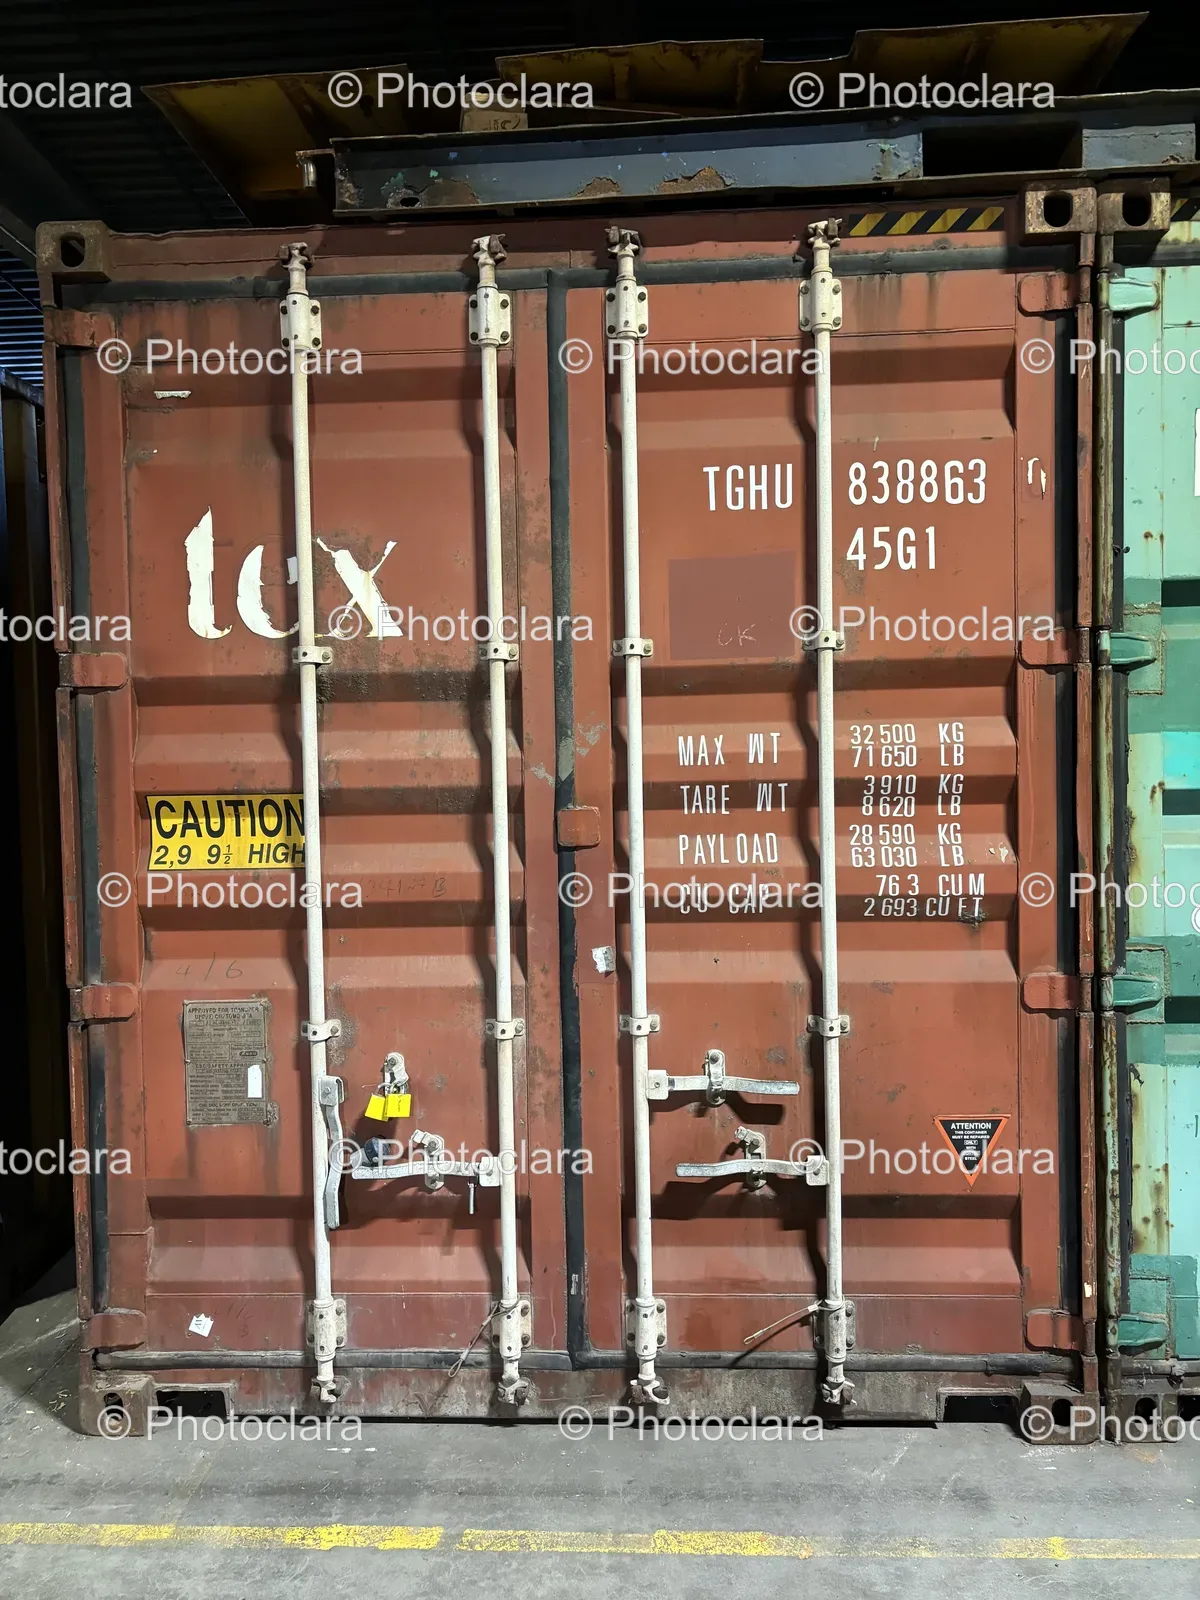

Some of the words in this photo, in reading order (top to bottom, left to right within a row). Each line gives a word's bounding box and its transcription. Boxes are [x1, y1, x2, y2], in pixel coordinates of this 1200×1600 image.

[703, 463, 793, 511] TGHU
[849, 459, 987, 505] 838863
[846, 526, 936, 570] 45G1
[938, 722, 964, 743] KG
[678, 735, 725, 766] MAX
[748, 733, 780, 764] WT
[940, 744, 964, 767] LB
[938, 774, 964, 794] KG
[680, 785, 730, 815] TARE
[756, 783, 788, 812] WT
[937, 795, 961, 816] LB
[154, 799, 306, 839] CAUTION
[937, 823, 962, 845] KG
[154, 845, 192, 868] 2,9
[679, 833, 779, 865] PAYLOAD
[939, 845, 965, 867] LB
[681, 884, 708, 914] CU
[728, 884, 769, 914] CAP
[925, 897, 950, 917] CU
